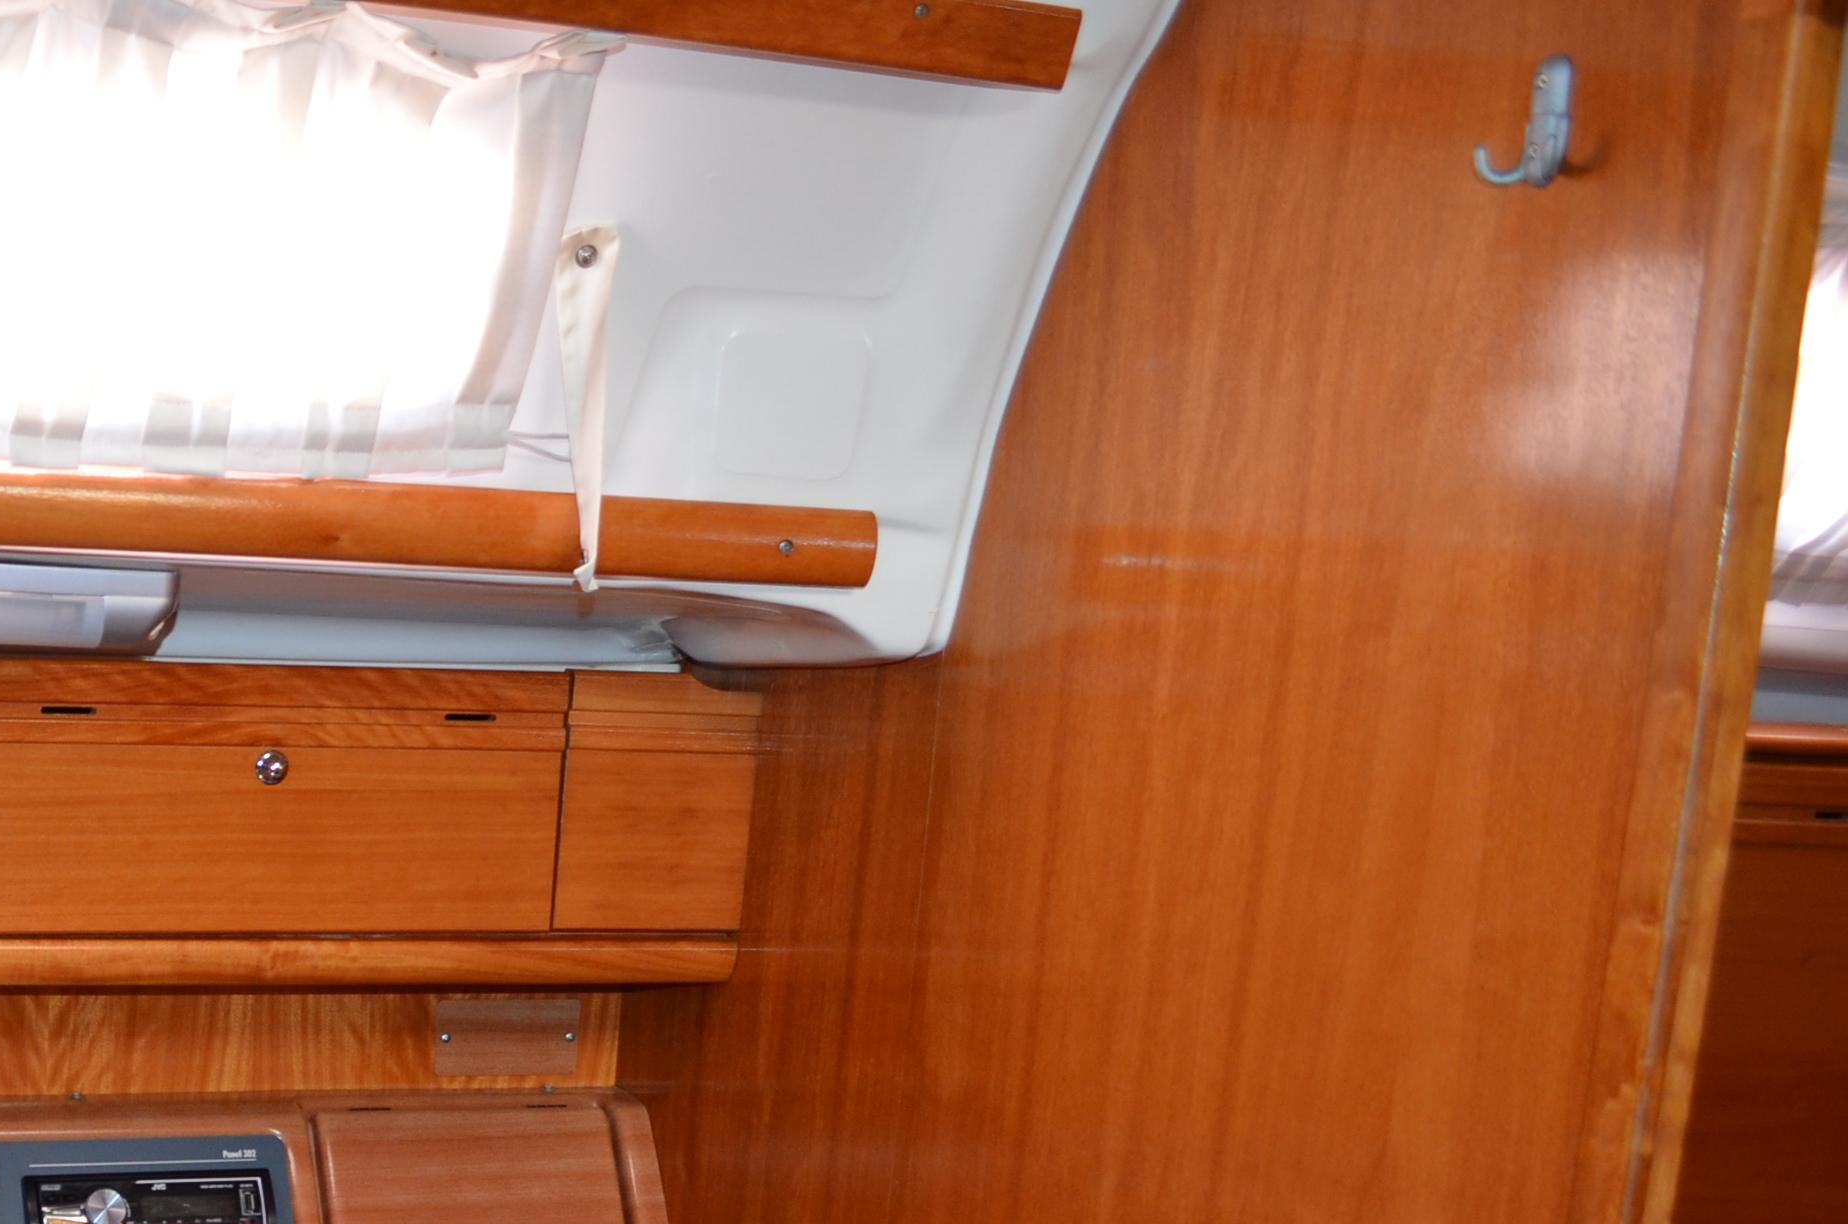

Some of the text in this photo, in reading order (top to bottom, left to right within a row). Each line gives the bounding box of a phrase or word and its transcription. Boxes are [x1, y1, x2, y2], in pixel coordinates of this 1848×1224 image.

[222, 1148, 256, 1158] Panel 302
[151, 1183, 167, 1191] JVC
